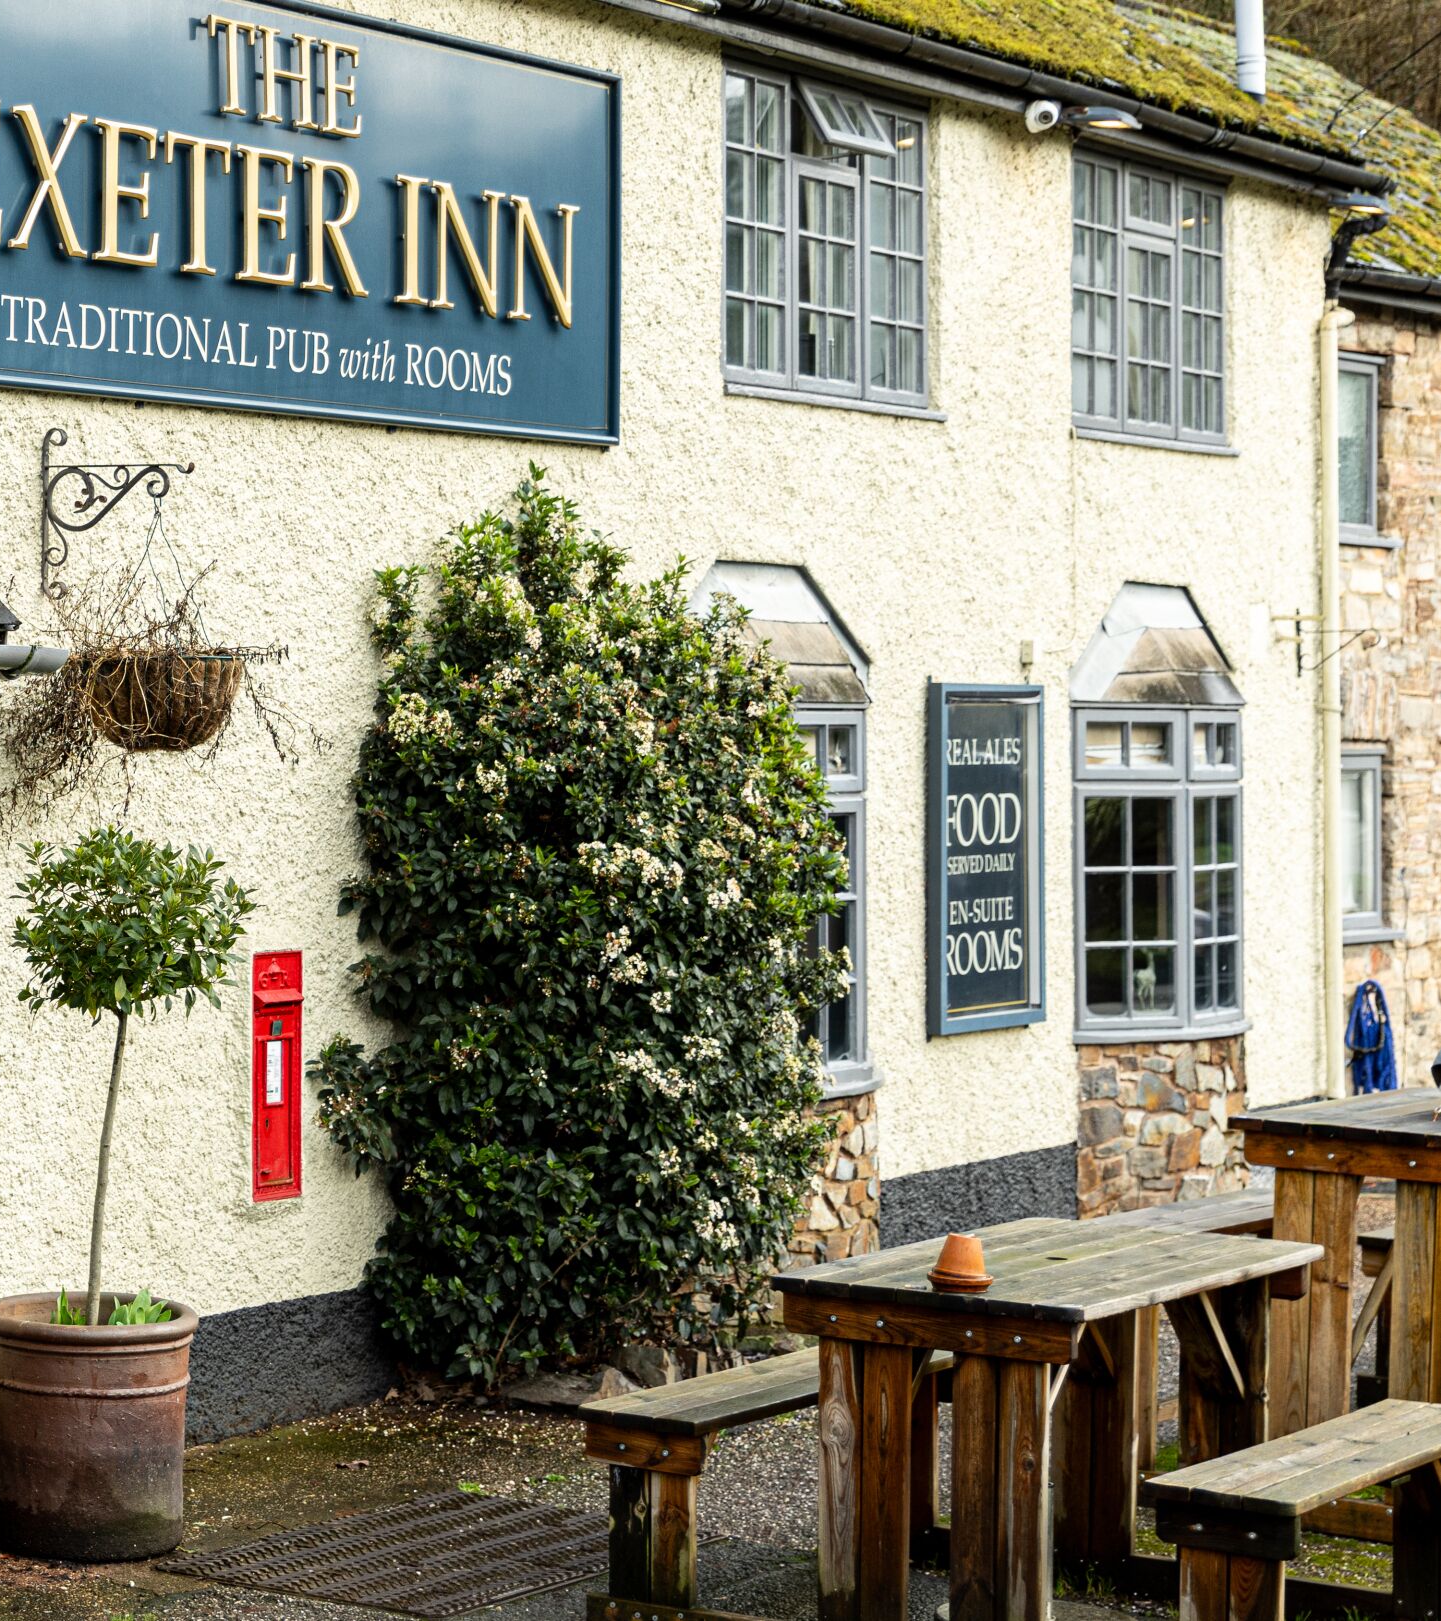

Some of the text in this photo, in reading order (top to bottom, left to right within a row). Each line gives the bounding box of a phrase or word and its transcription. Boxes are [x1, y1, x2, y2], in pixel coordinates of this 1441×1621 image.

[206, 14, 361, 138] THE
[393, 174, 581, 330] INN
[1, 294, 512, 397] TRADITIONAL PUB with ROOMS
[946, 737, 1021, 766] REAL ALES
[947, 792, 1022, 847] FOOD
[947, 852, 1016, 876] SERVED DAILY
[949, 896, 1014, 926] EN-SUITE
[946, 927, 1023, 977] ROOMS
